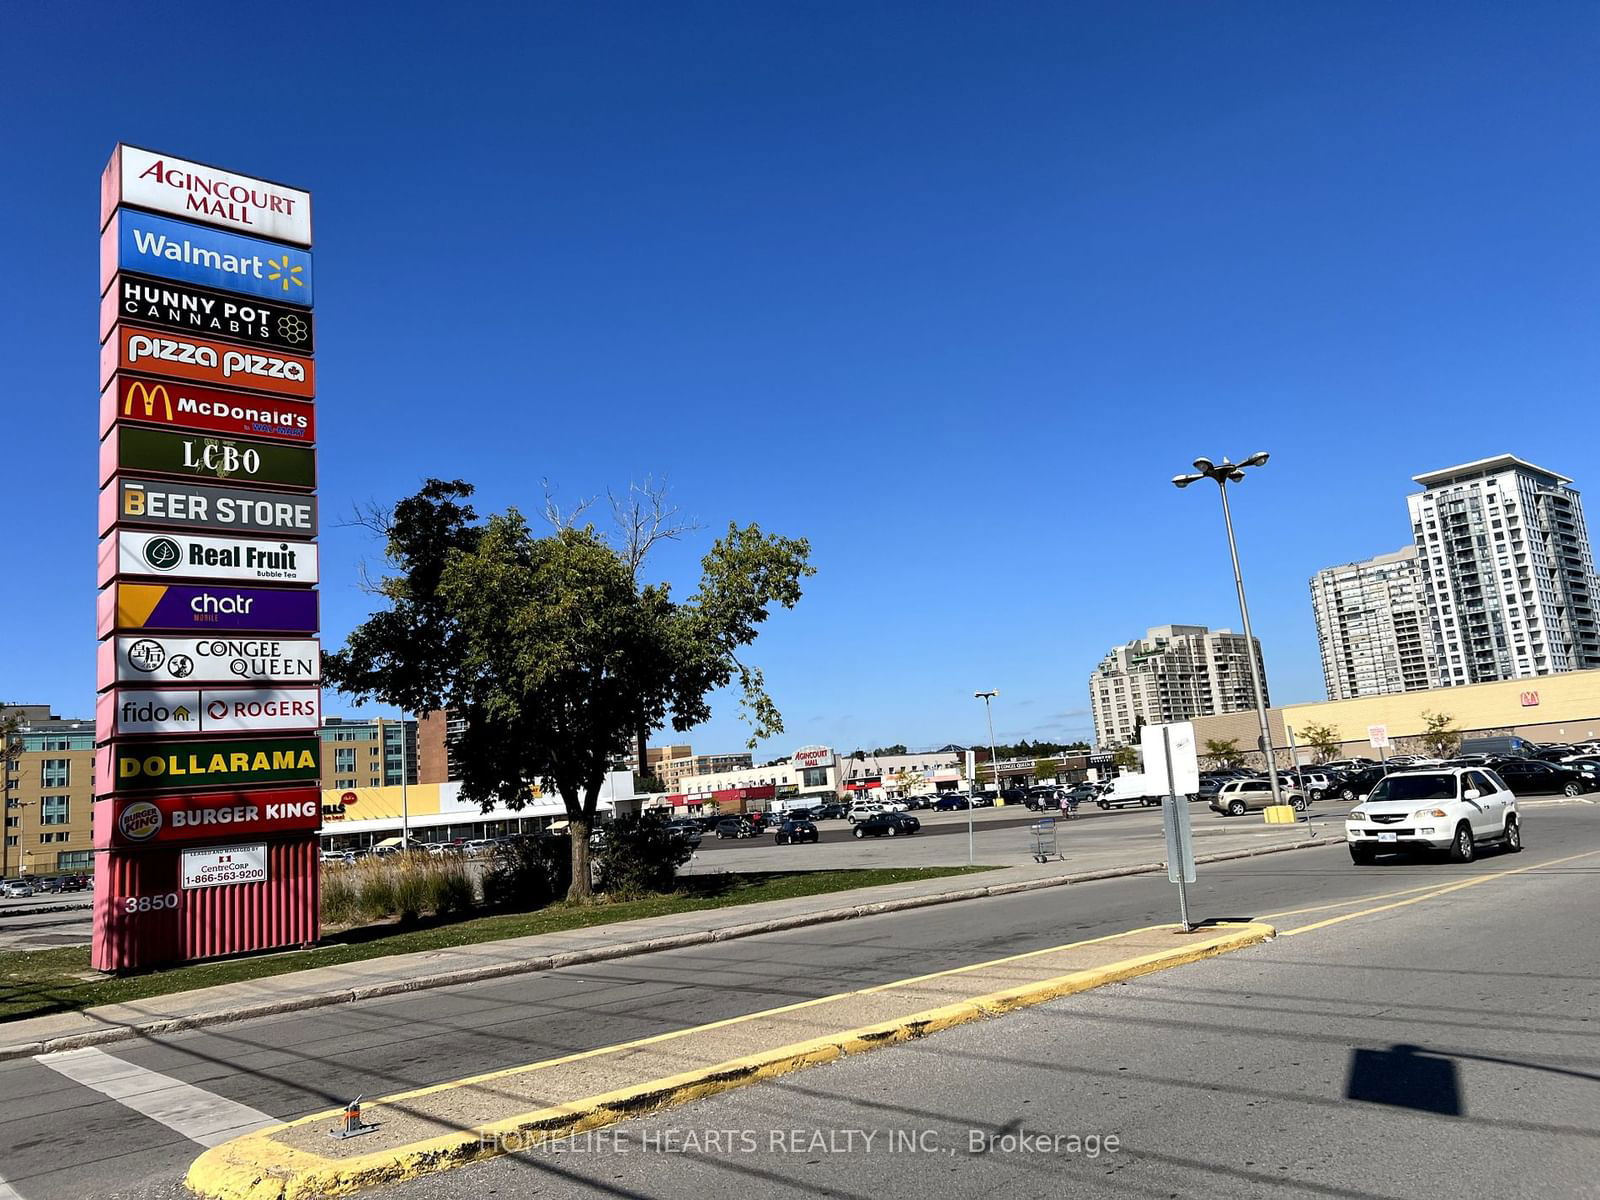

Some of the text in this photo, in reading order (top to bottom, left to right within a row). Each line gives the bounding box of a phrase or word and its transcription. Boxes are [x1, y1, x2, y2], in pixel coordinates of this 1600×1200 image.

[139, 160, 296, 216] AGINCOURT
[186, 193, 253, 225] MALL
[133, 229, 263, 279] Walmart
[125, 283, 271, 325] HUNNY POT
[125, 301, 270, 338] CANNABIS
[177, 398, 308, 428] McDonald's
[183, 441, 260, 474] LCBO
[124, 485, 312, 529] BEER STORE
[189, 543, 297, 570] Real Fruit
[256, 570, 297, 579] Bubble Tea
[190, 593, 254, 614] chatr
[195, 640, 282, 657] CONGEE
[229, 658, 313, 678] QUEEN
[121, 702, 169, 723] fido
[234, 700, 315, 718] ROGERS
[119, 749, 316, 778] DOLLARAMA
[124, 808, 157, 824] BURGER
[126, 815, 159, 834] KING
[172, 801, 317, 827] BURGER KING
[186, 869, 264, 885] 1-866-563-9200
[125, 892, 179, 913] 3850
